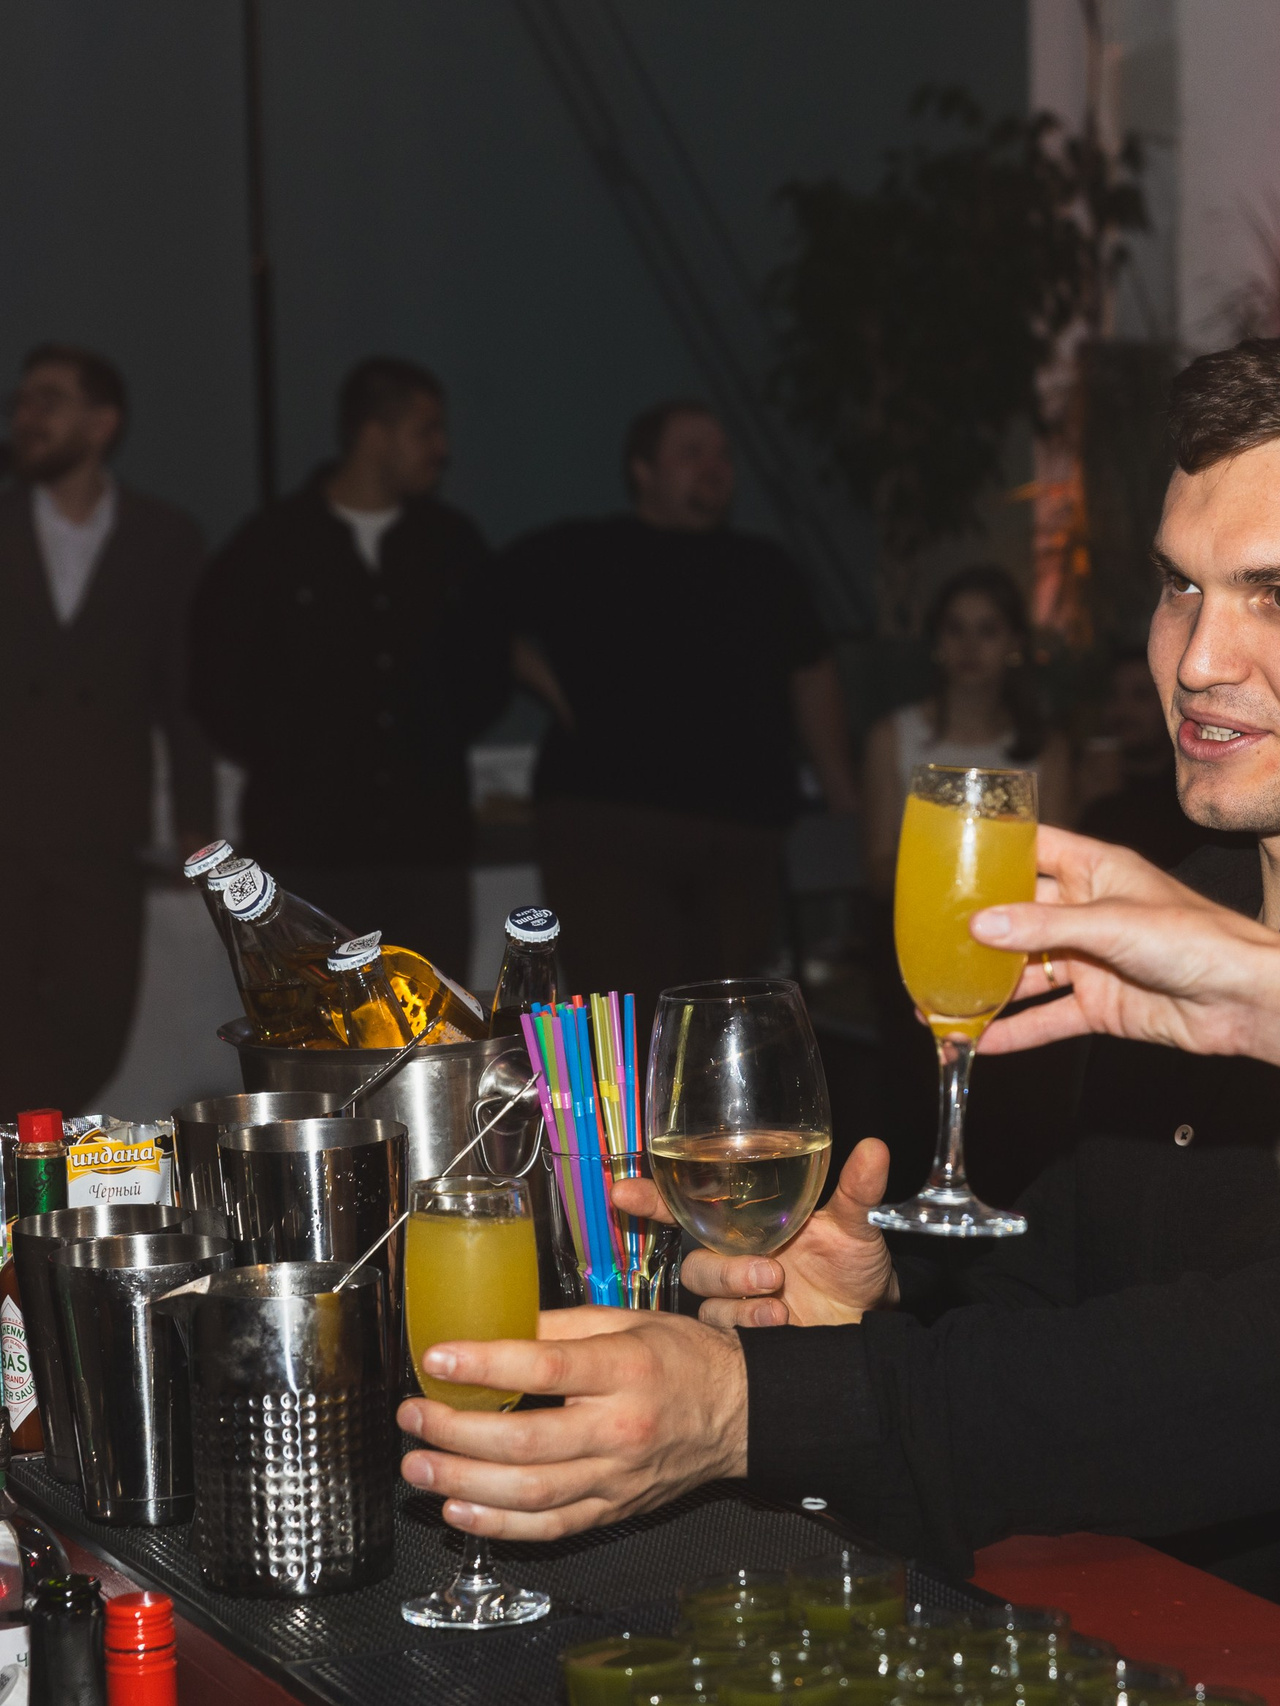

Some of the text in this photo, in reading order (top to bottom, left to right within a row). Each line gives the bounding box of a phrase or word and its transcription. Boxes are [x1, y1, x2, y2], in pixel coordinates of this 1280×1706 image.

[514, 909, 553, 925] Corona
[71, 1146, 154, 1167] индана
[88, 1181, 142, 1203] Черный
